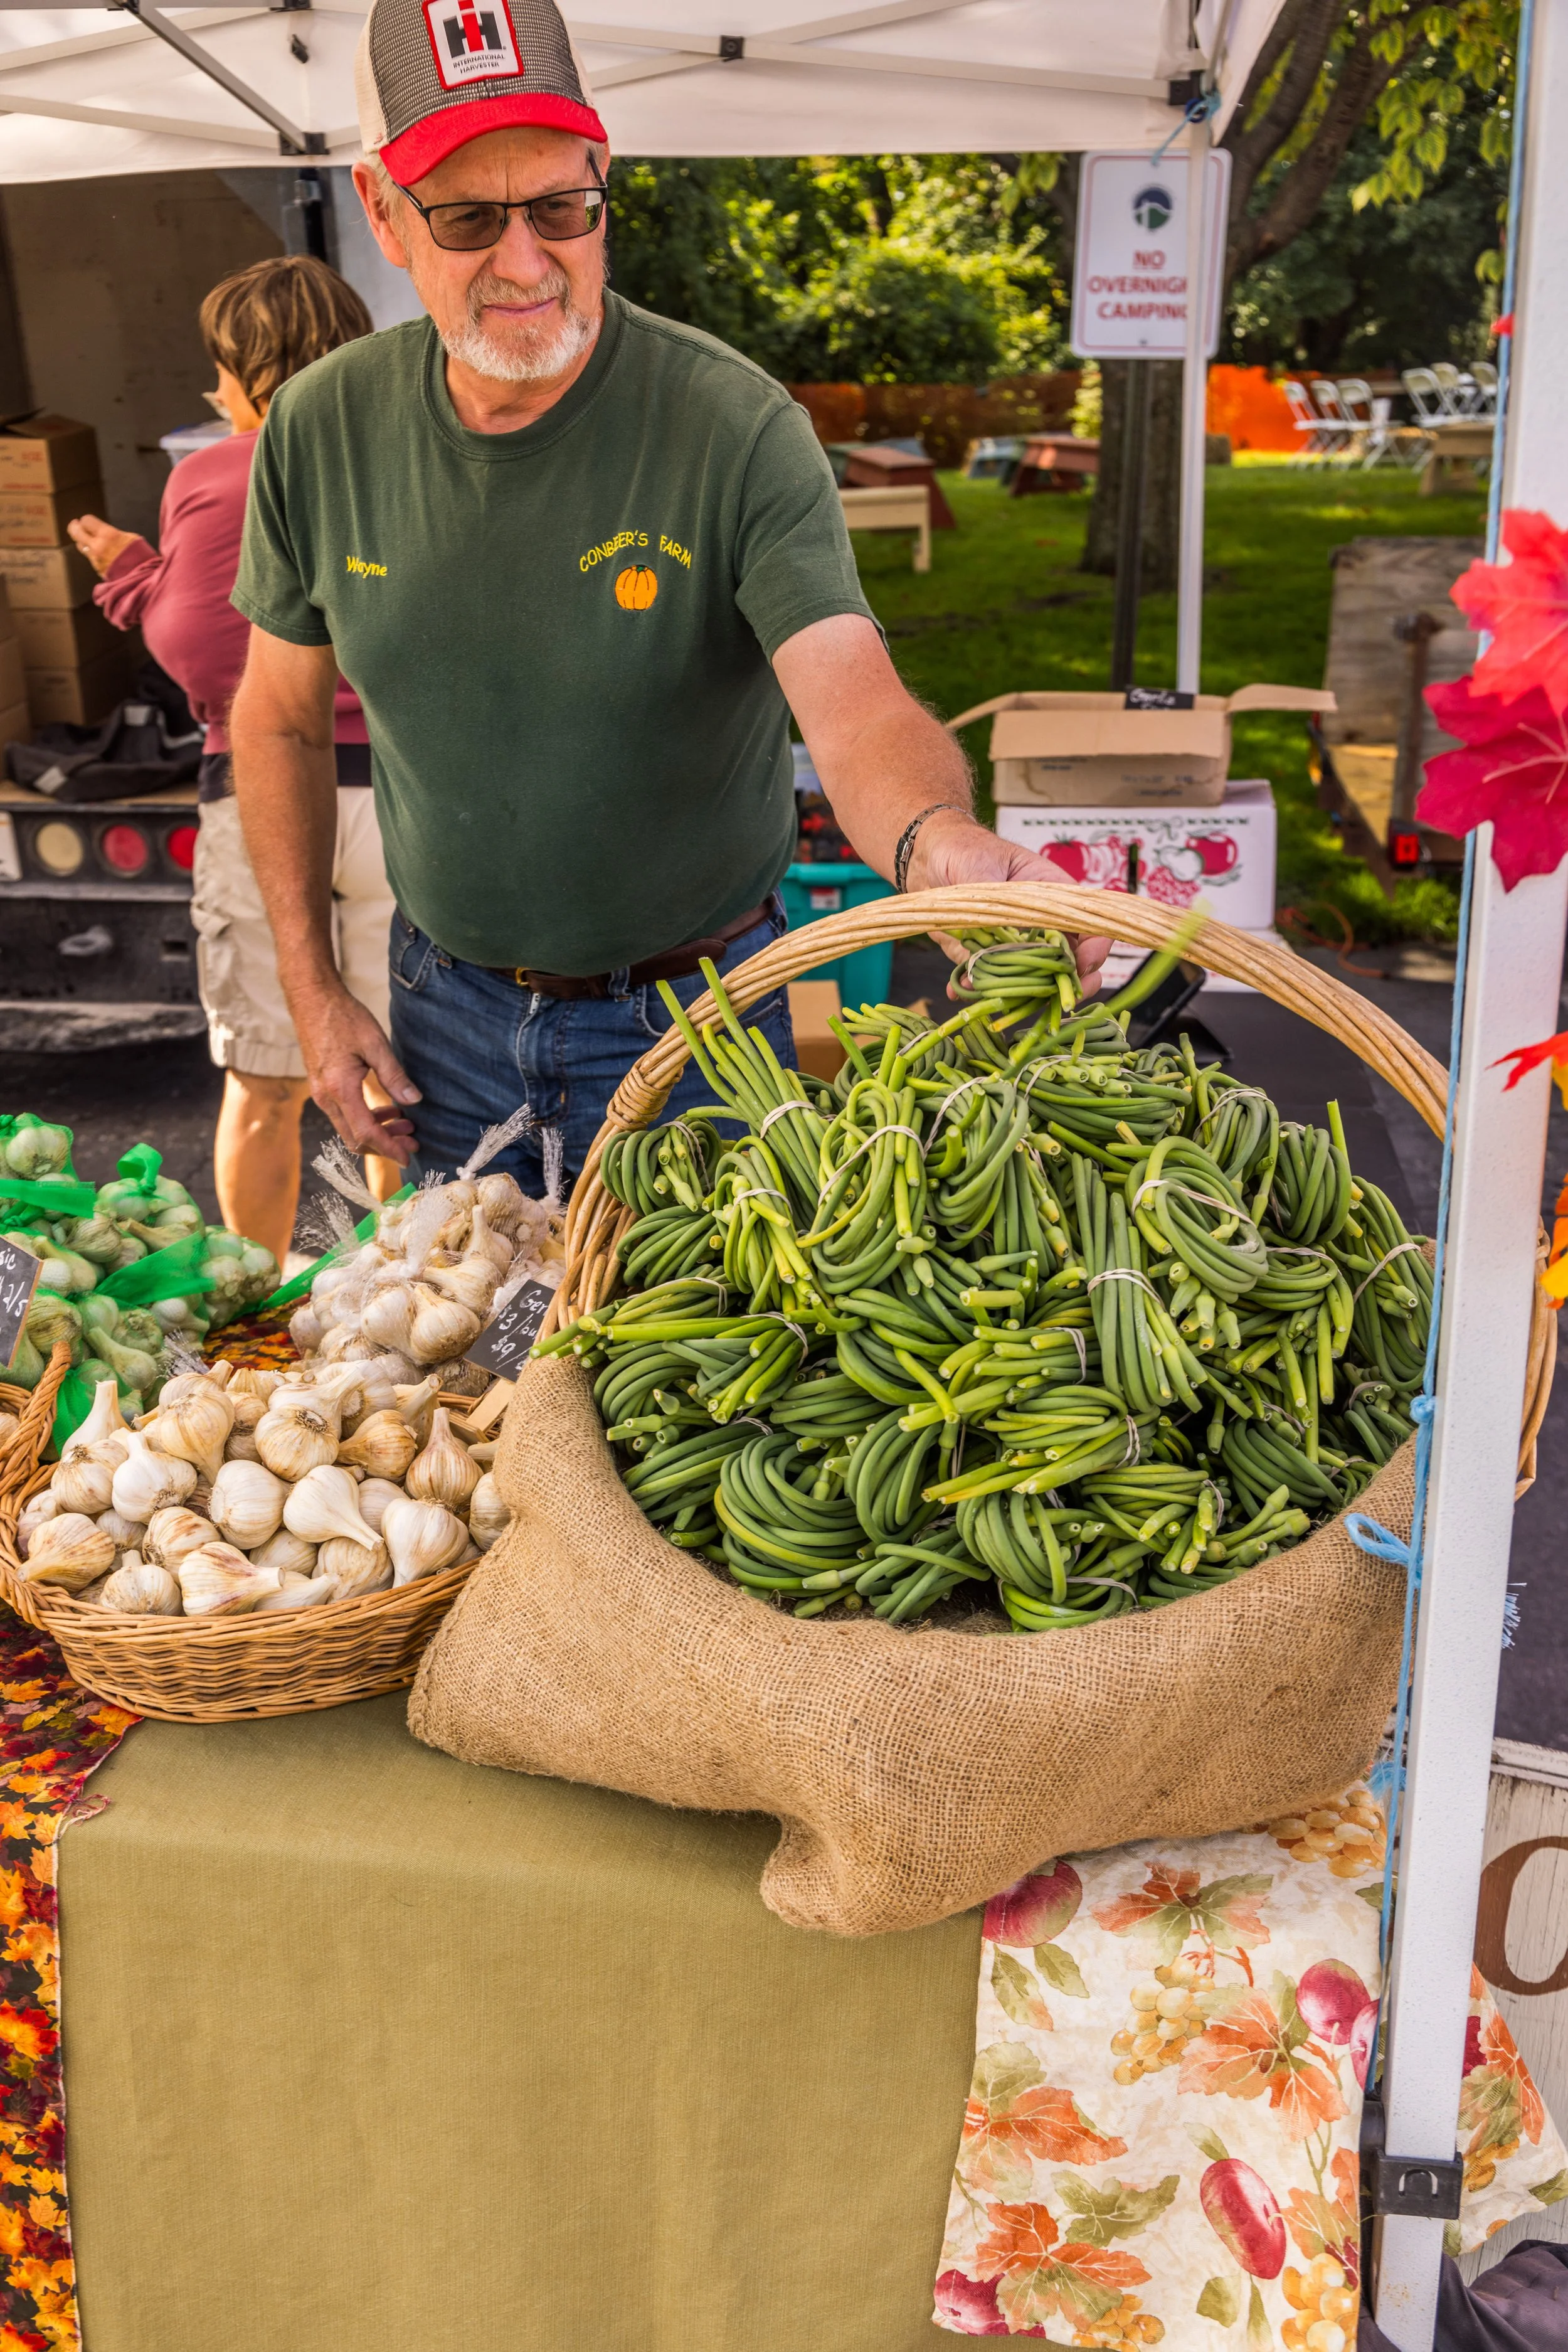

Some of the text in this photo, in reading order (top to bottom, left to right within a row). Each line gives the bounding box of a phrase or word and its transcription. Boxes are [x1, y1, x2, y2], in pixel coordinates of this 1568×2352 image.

[453, 53, 506, 68] INTERNATIONAL
[460, 61, 499, 74] HARVESTER
[1133, 250, 1165, 270] NO
[580, 530, 692, 572] CONBEER'S FARM
[346, 556, 388, 579] Wayne
[519, 1289, 549, 1314] Ger
